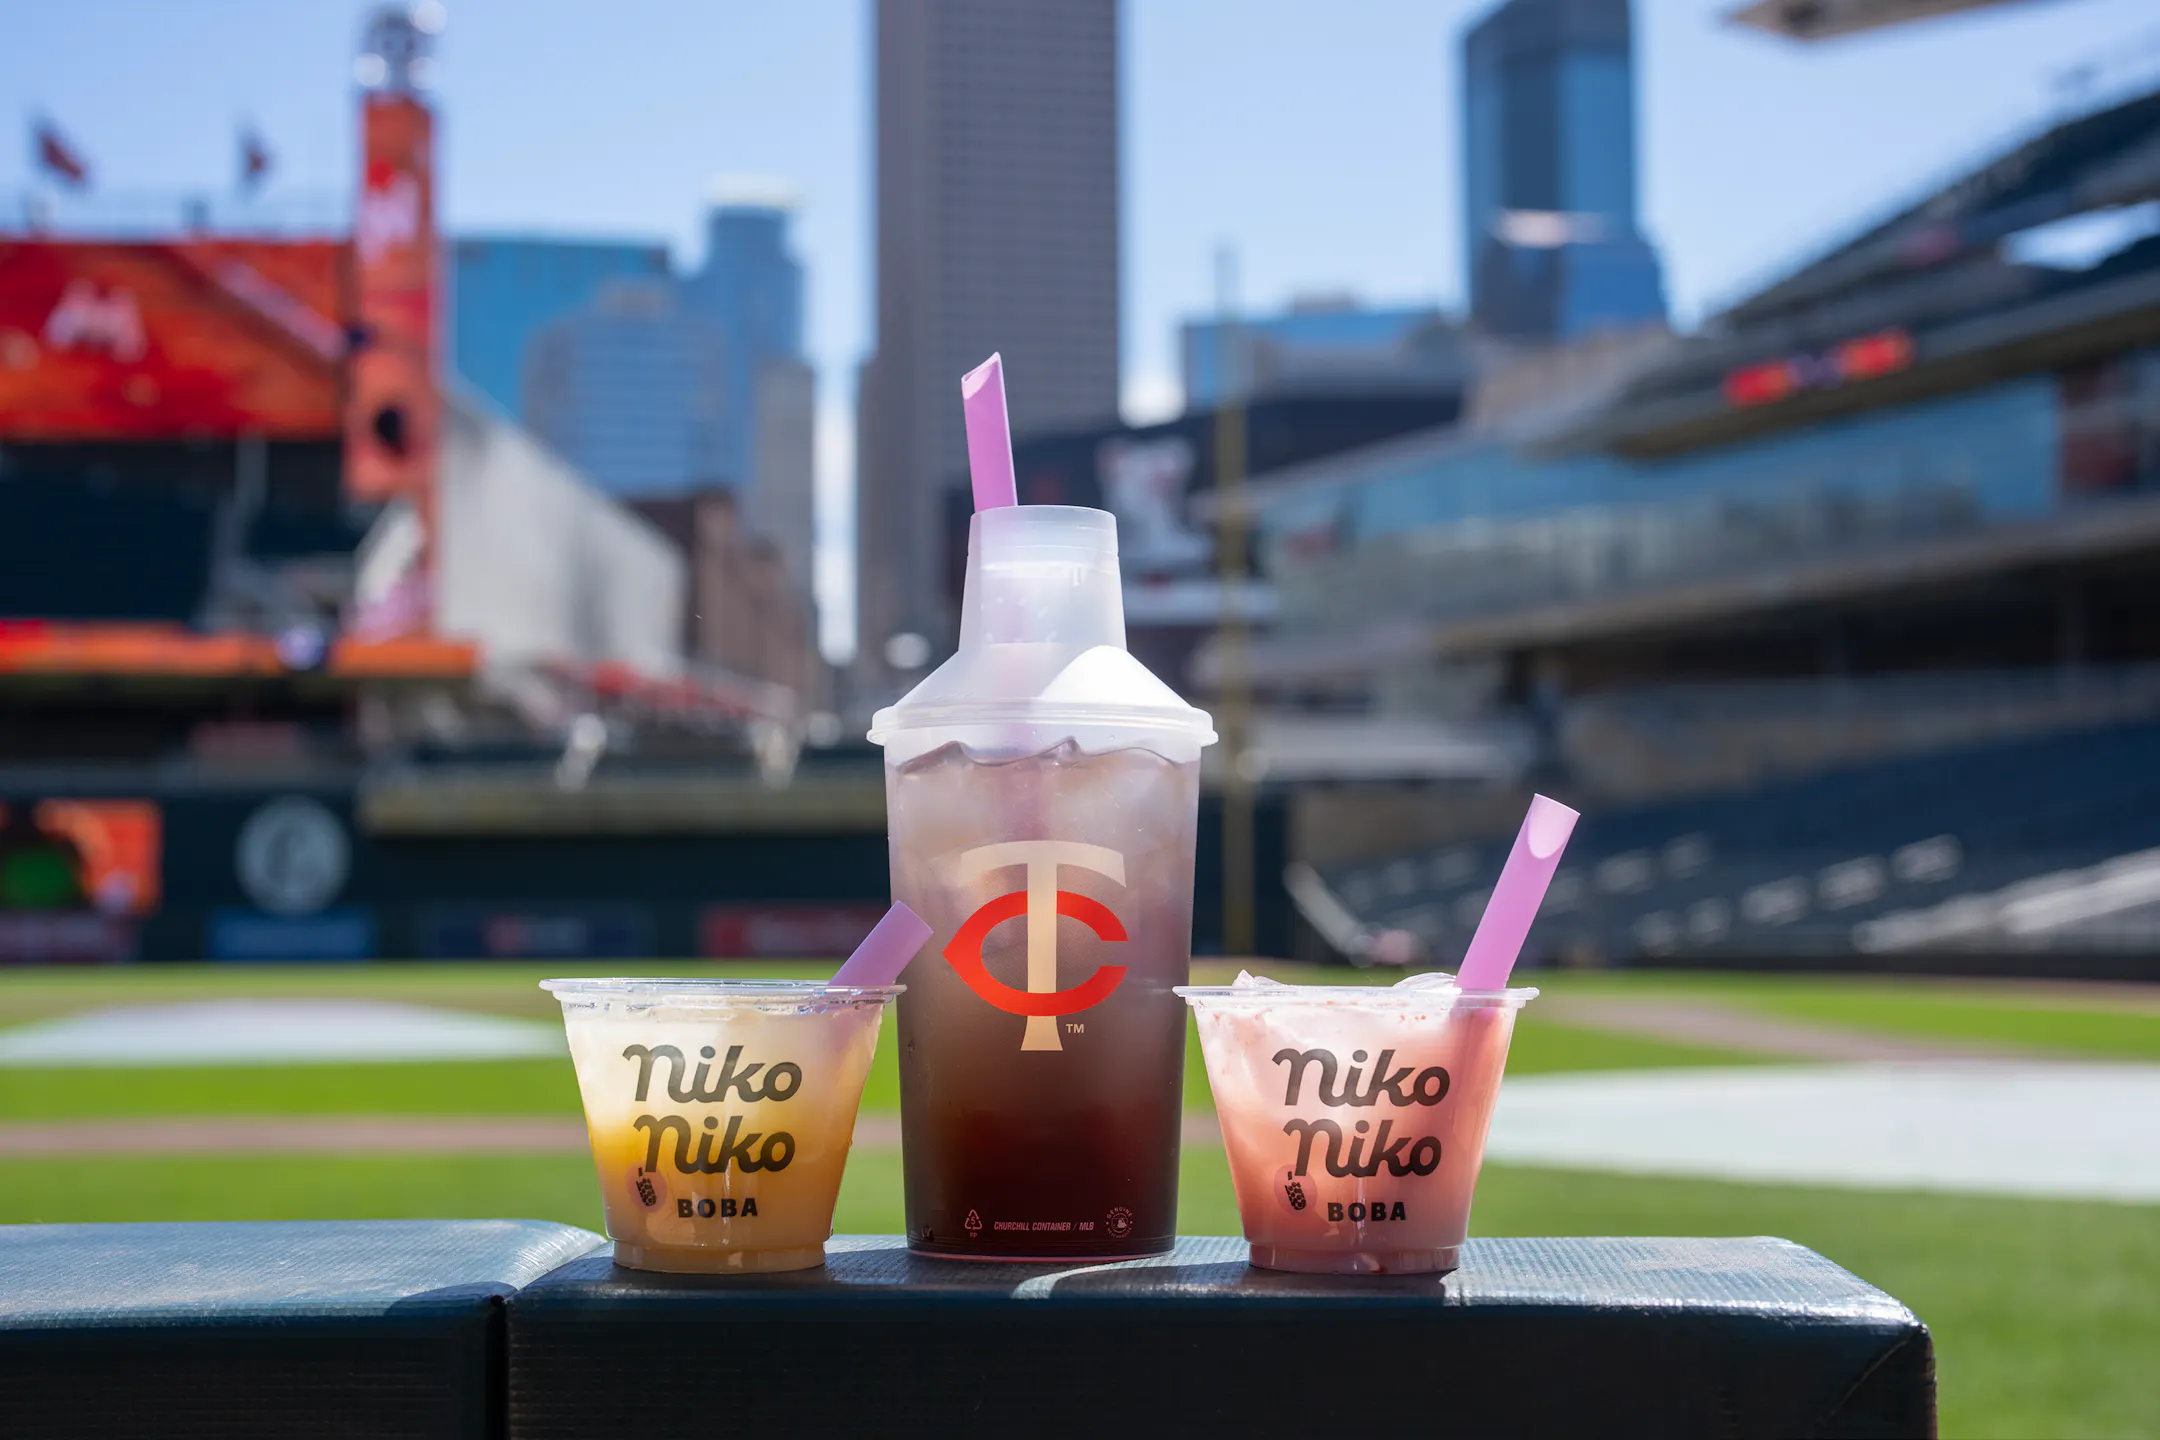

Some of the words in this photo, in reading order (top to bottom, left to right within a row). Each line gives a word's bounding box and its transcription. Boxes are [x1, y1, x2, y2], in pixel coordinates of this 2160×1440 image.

[1066, 1024, 1085, 1034] TM
[677, 1198, 758, 1218] BOBA
[1327, 1202, 1406, 1222] BOBA
[993, 1221, 1030, 1231] CHURCHILL
[1031, 1221, 1071, 1231] CONTAINER
[1079, 1221, 1095, 1231] MLB
